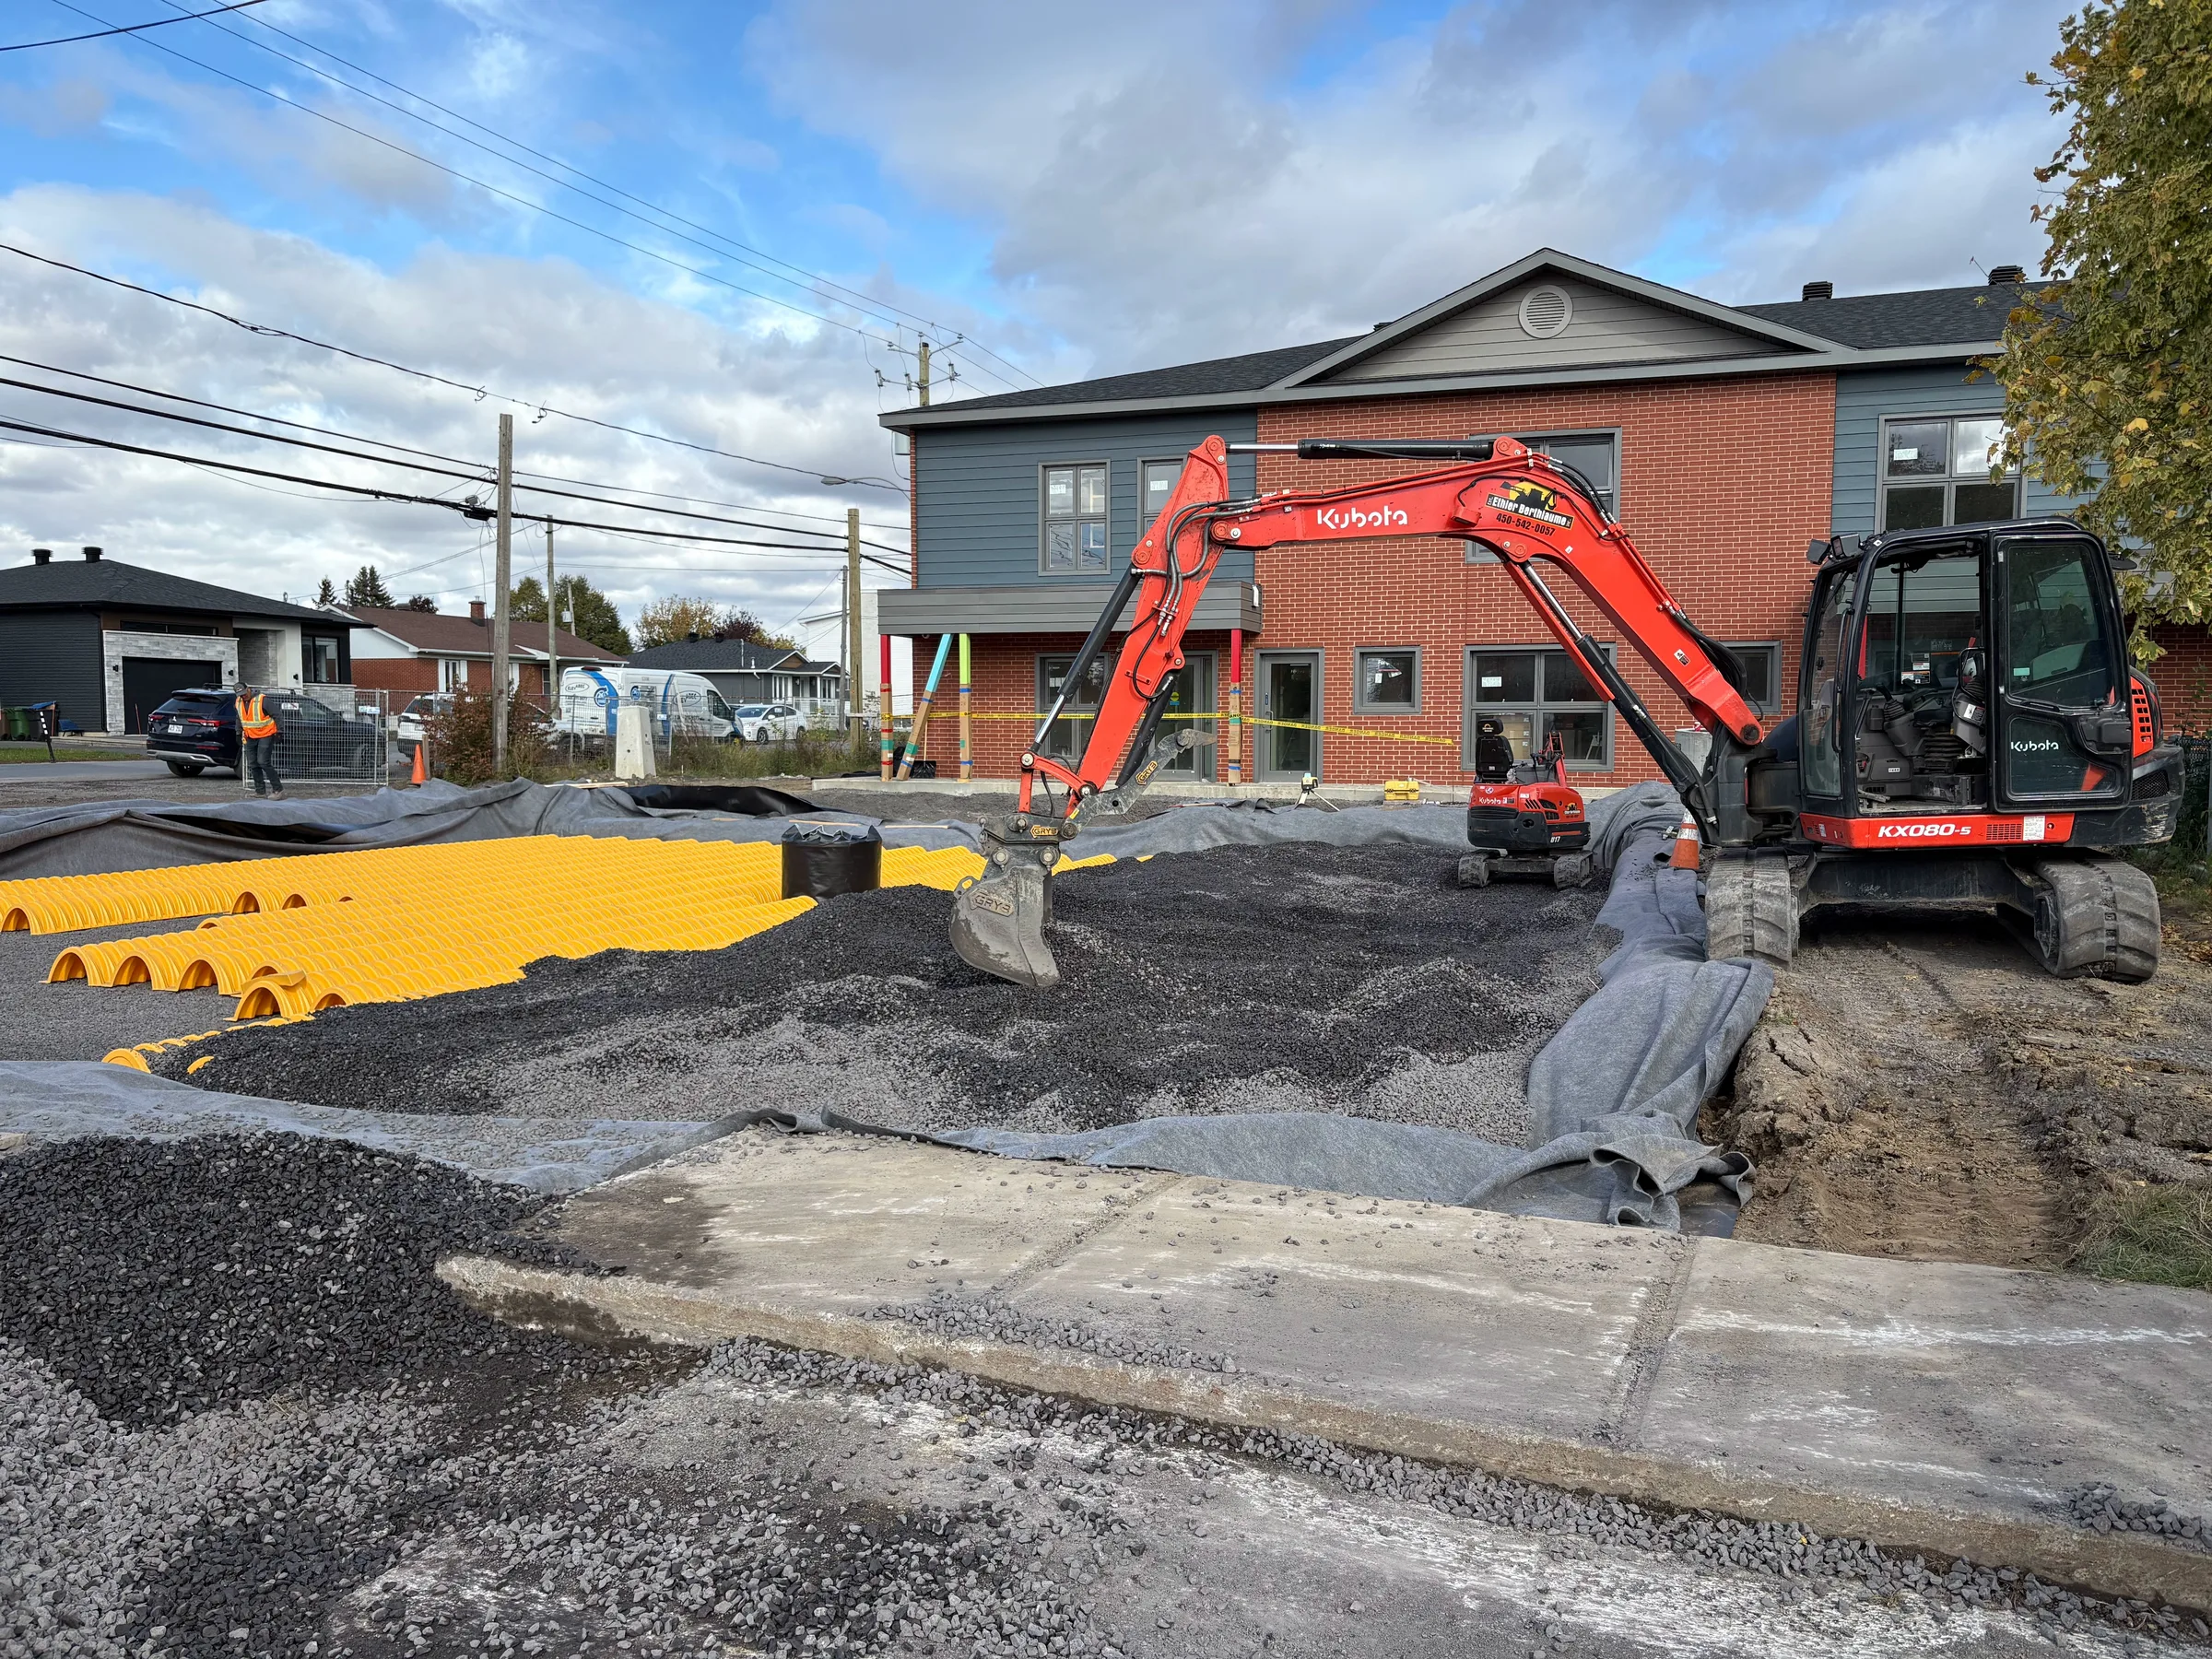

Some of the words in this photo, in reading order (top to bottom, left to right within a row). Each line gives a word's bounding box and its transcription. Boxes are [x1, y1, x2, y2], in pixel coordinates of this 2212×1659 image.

[1317, 505, 1408, 530] Kubota
[1492, 496, 1518, 512] Ethier
[1518, 503, 1567, 526] Berthiaume
[1496, 512, 1556, 536] 450-542-0057
[2011, 740, 2059, 752] Kubota
[1877, 824, 1971, 838] KX080-5
